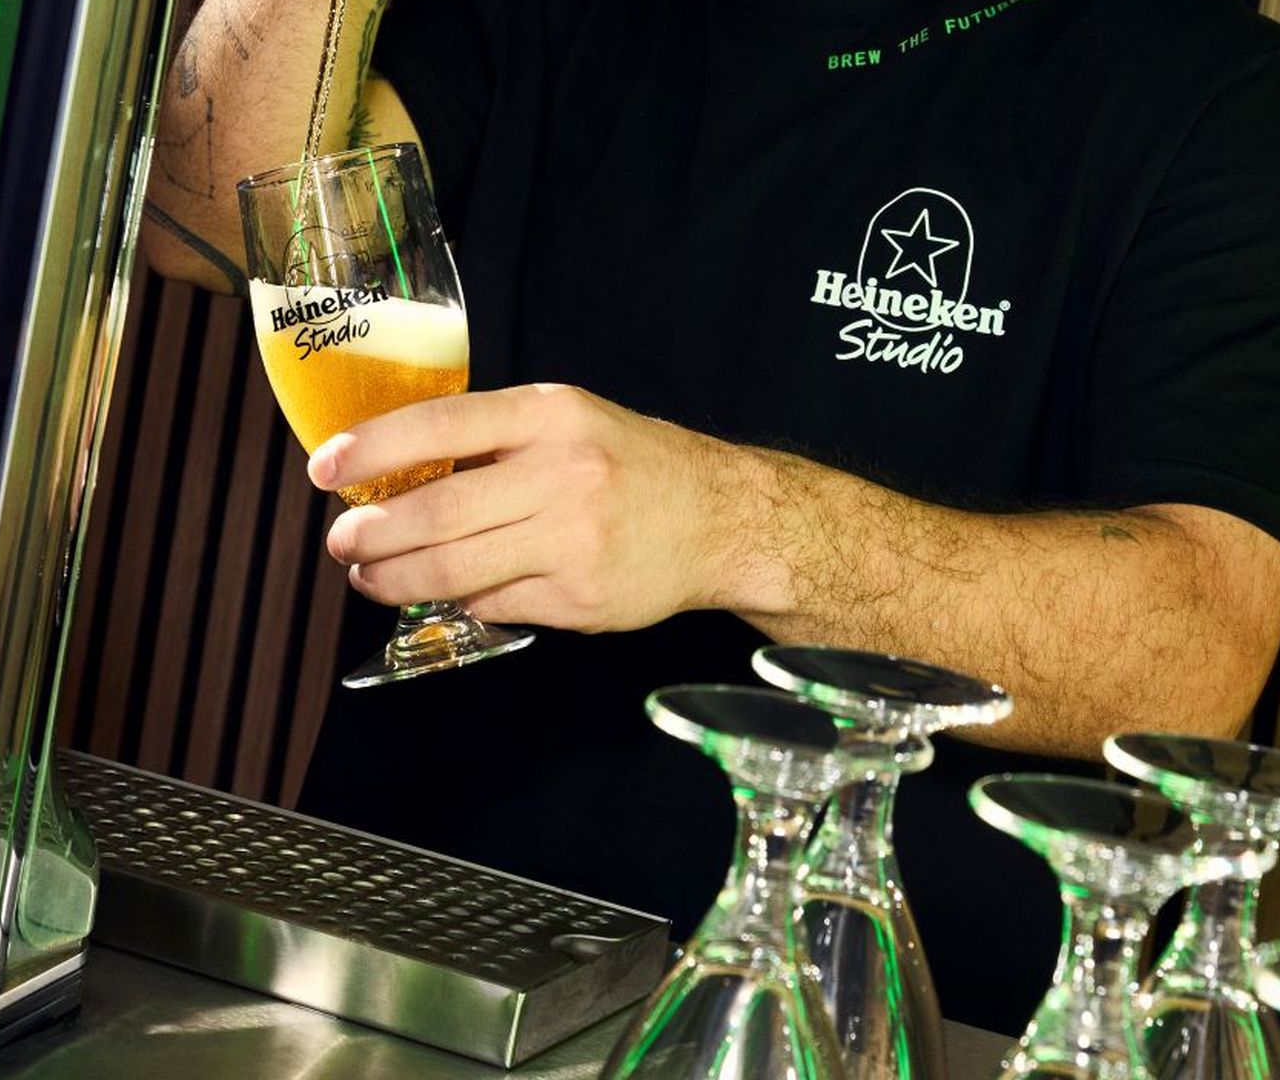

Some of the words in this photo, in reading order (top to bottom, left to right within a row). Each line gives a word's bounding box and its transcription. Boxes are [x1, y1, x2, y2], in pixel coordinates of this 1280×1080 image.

[827, 49, 881, 70] BREW
[898, 27, 930, 54] THE
[270, 283, 389, 332] Heineken
[294, 315, 371, 360] Studio
[835, 319, 964, 375] Studio
